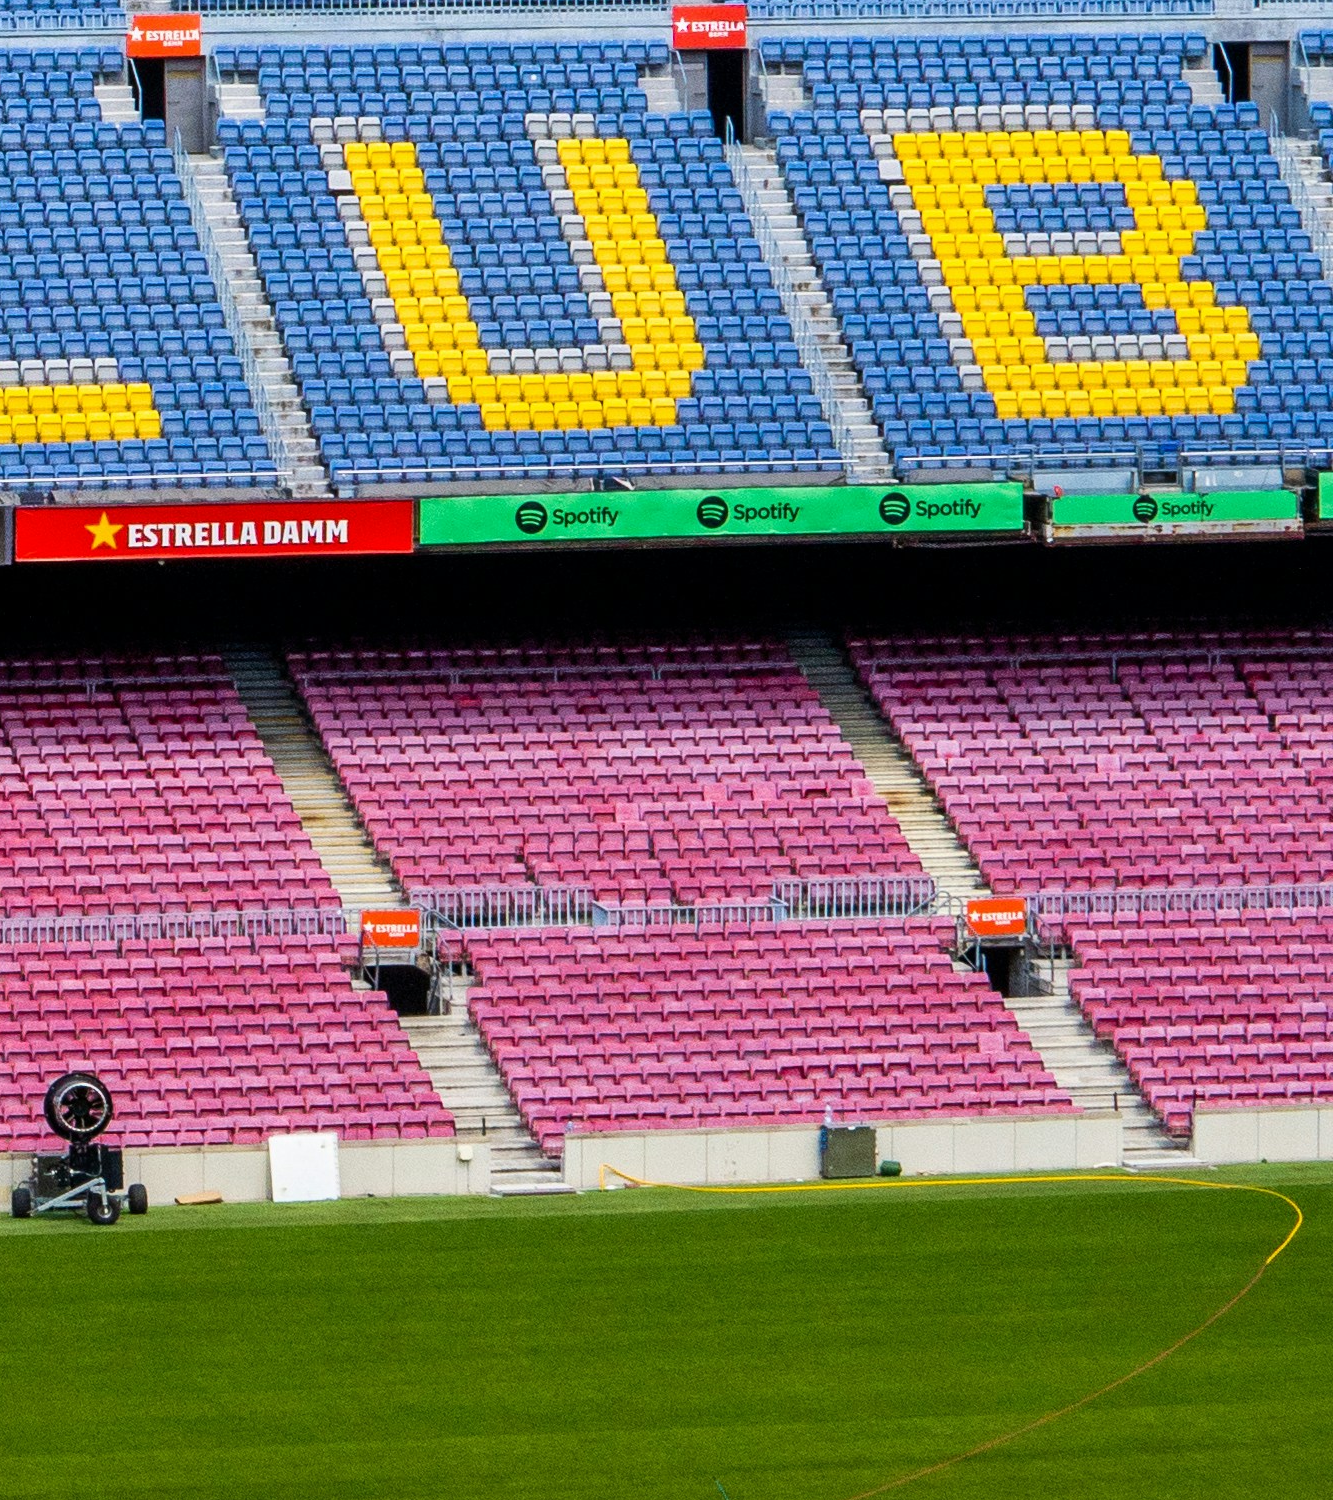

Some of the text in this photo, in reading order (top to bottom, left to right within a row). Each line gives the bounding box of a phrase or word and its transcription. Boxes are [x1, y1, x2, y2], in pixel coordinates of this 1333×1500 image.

[146, 29, 200, 41] ESTRELLA
[692, 21, 745, 32] ESTRELLA
[552, 506, 618, 527] Spotify
[733, 502, 799, 523] Spotify
[915, 498, 981, 519] Spotify
[1161, 499, 1213, 517] Spotify
[127, 519, 349, 549] ESTRELLA DAMM
[981, 911, 1024, 921] ESTRELLA
[376, 924, 418, 934] ESTRELLA
